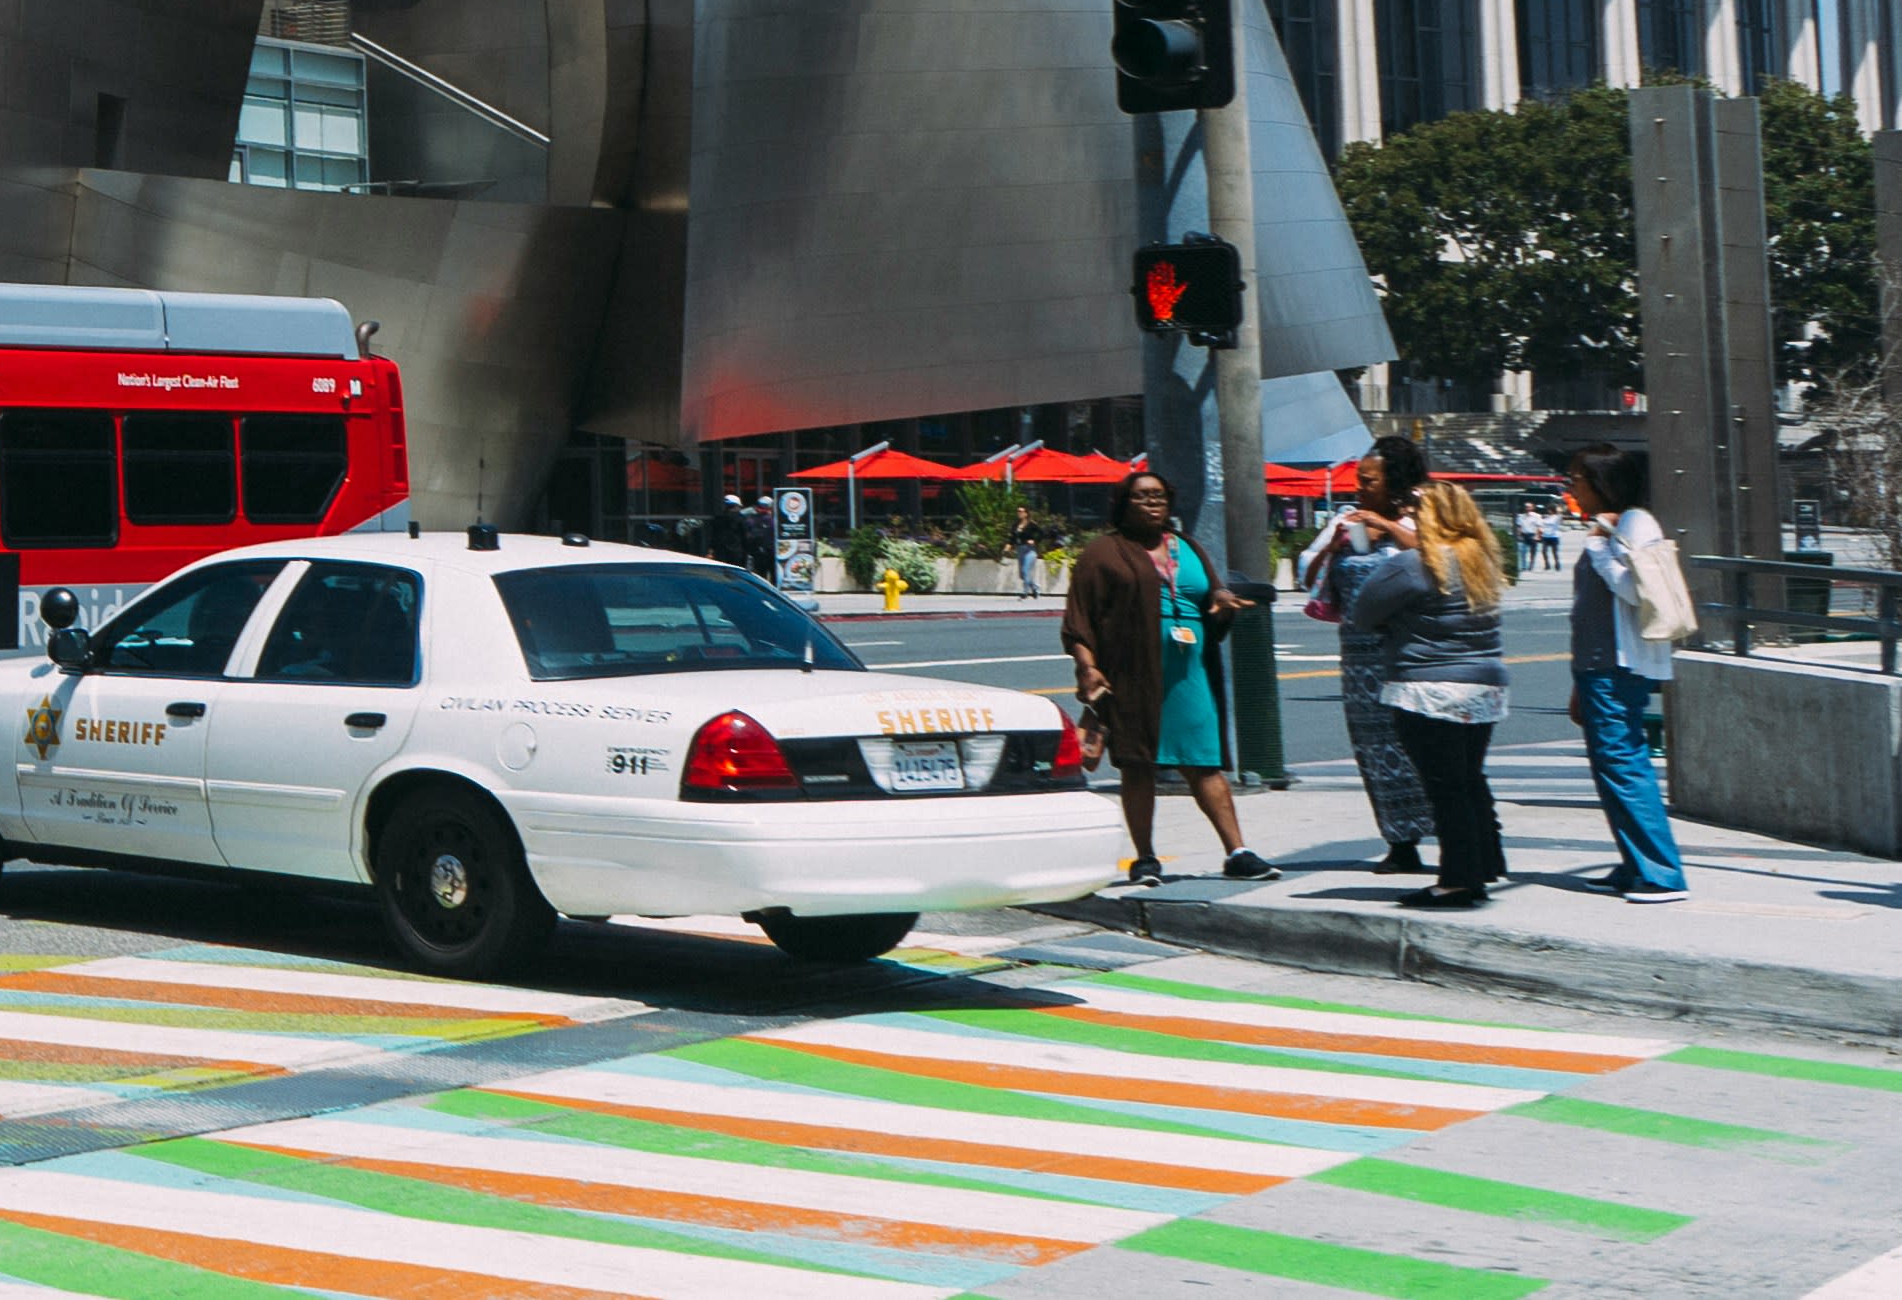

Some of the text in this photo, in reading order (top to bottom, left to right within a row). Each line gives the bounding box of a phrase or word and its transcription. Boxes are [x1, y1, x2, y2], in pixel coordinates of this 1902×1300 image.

[152, 373, 181, 391] Largest
[513, 699, 594, 717] PROCESS
[599, 705, 672, 723] SERVER
[875, 708, 995, 734] SHERIFF
[75, 718, 167, 746] SHERIFF
[612, 754, 647, 775] 911
